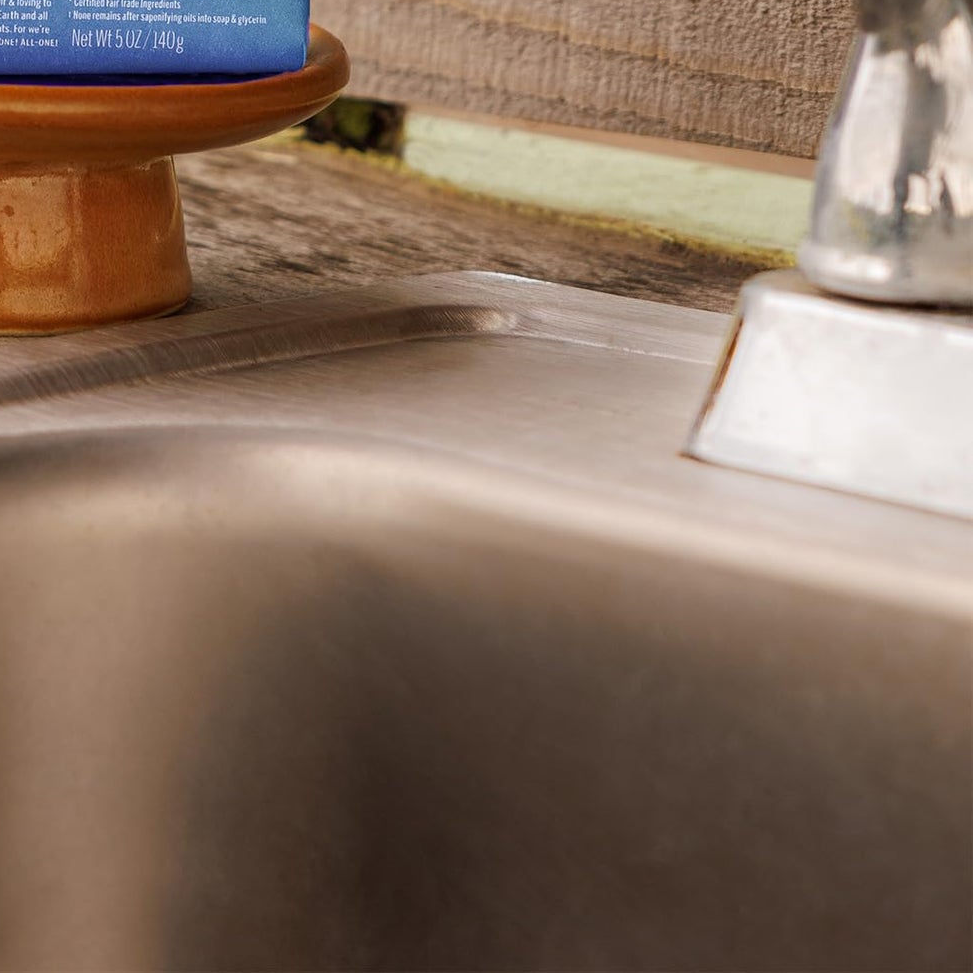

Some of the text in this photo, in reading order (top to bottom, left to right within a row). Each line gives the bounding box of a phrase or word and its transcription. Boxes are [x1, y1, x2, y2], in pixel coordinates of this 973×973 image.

[43, 0, 52, 7] to
[21, 11, 36, 20] and
[38, 11, 48, 21] all
[73, 10, 267, 25] None remains after saponifying oils into soap & glycerin
[14, 24, 26, 33] For
[28, 25, 50, 34] we're
[20, 38, 58, 47] ALL-ONE!
[72, 29, 93, 47] Net
[96, 29, 112, 48] Wt
[115, 29, 123, 48] 5
